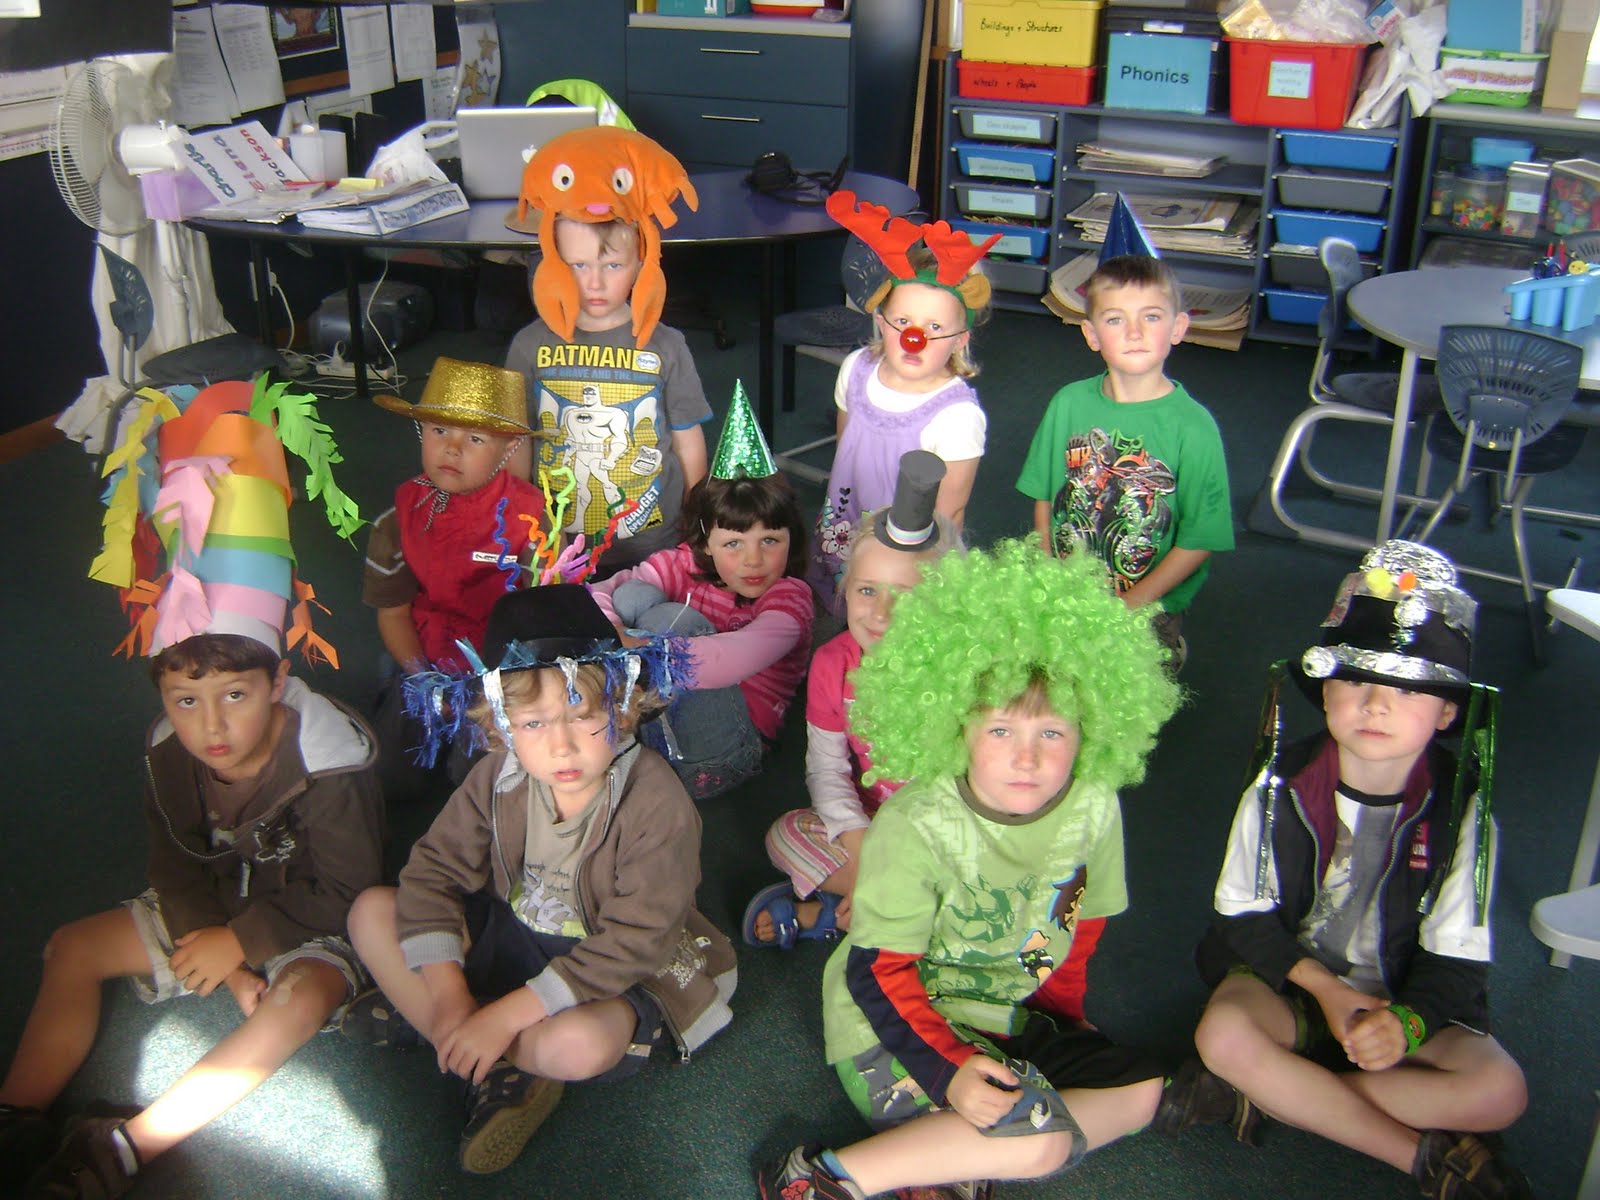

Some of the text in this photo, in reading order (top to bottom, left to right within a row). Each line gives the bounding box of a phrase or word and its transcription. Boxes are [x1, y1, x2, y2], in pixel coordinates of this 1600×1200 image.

[1120, 65, 1189, 84] Phonics
[536, 344, 633, 369] BATMAN
[591, 368, 611, 380] AND
[614, 370, 632, 381] THE
[625, 485, 660, 526] GADGET
